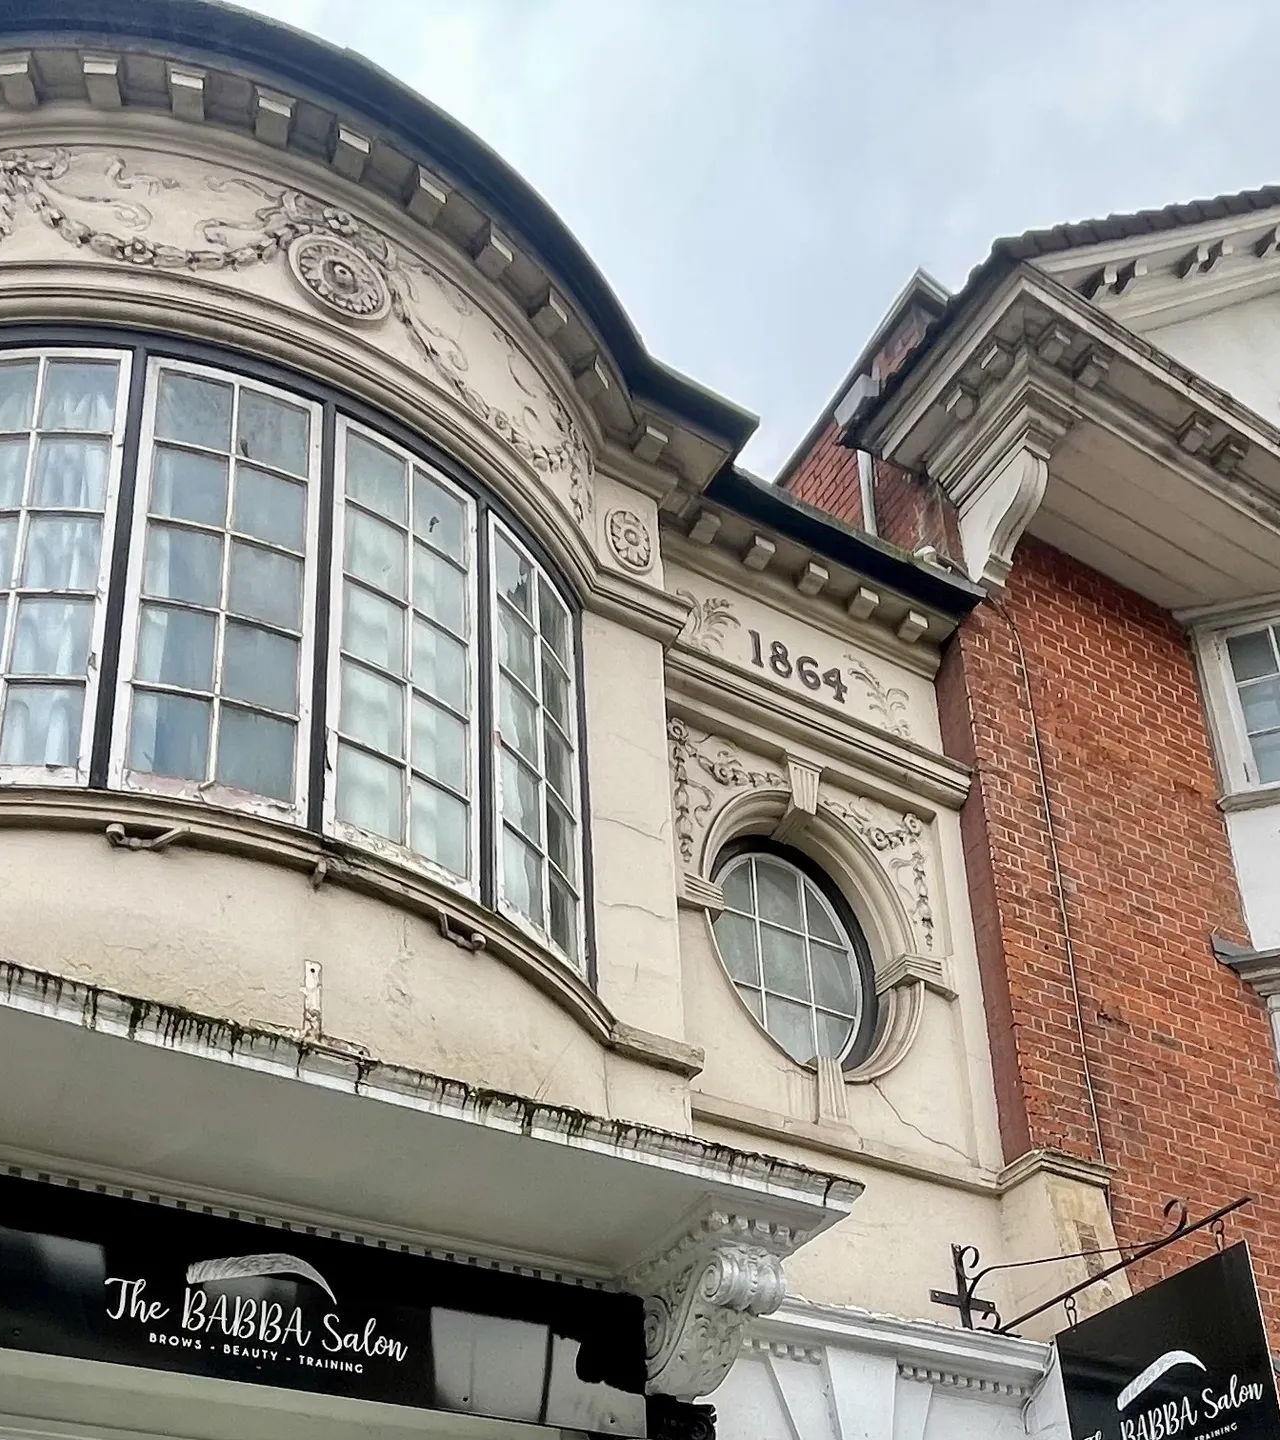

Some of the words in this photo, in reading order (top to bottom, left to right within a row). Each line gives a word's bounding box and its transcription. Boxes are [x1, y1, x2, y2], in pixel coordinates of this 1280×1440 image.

[747, 629, 849, 704] 1864
[104, 1277, 170, 1323] The
[181, 1286, 312, 1348] BABBA
[321, 1313, 409, 1362] Salon
[149, 1332, 202, 1350] BROWS
[223, 1344, 278, 1362] BEAUTY
[298, 1354, 365, 1374] TRAINING
[1201, 1373, 1264, 1419] Salon
